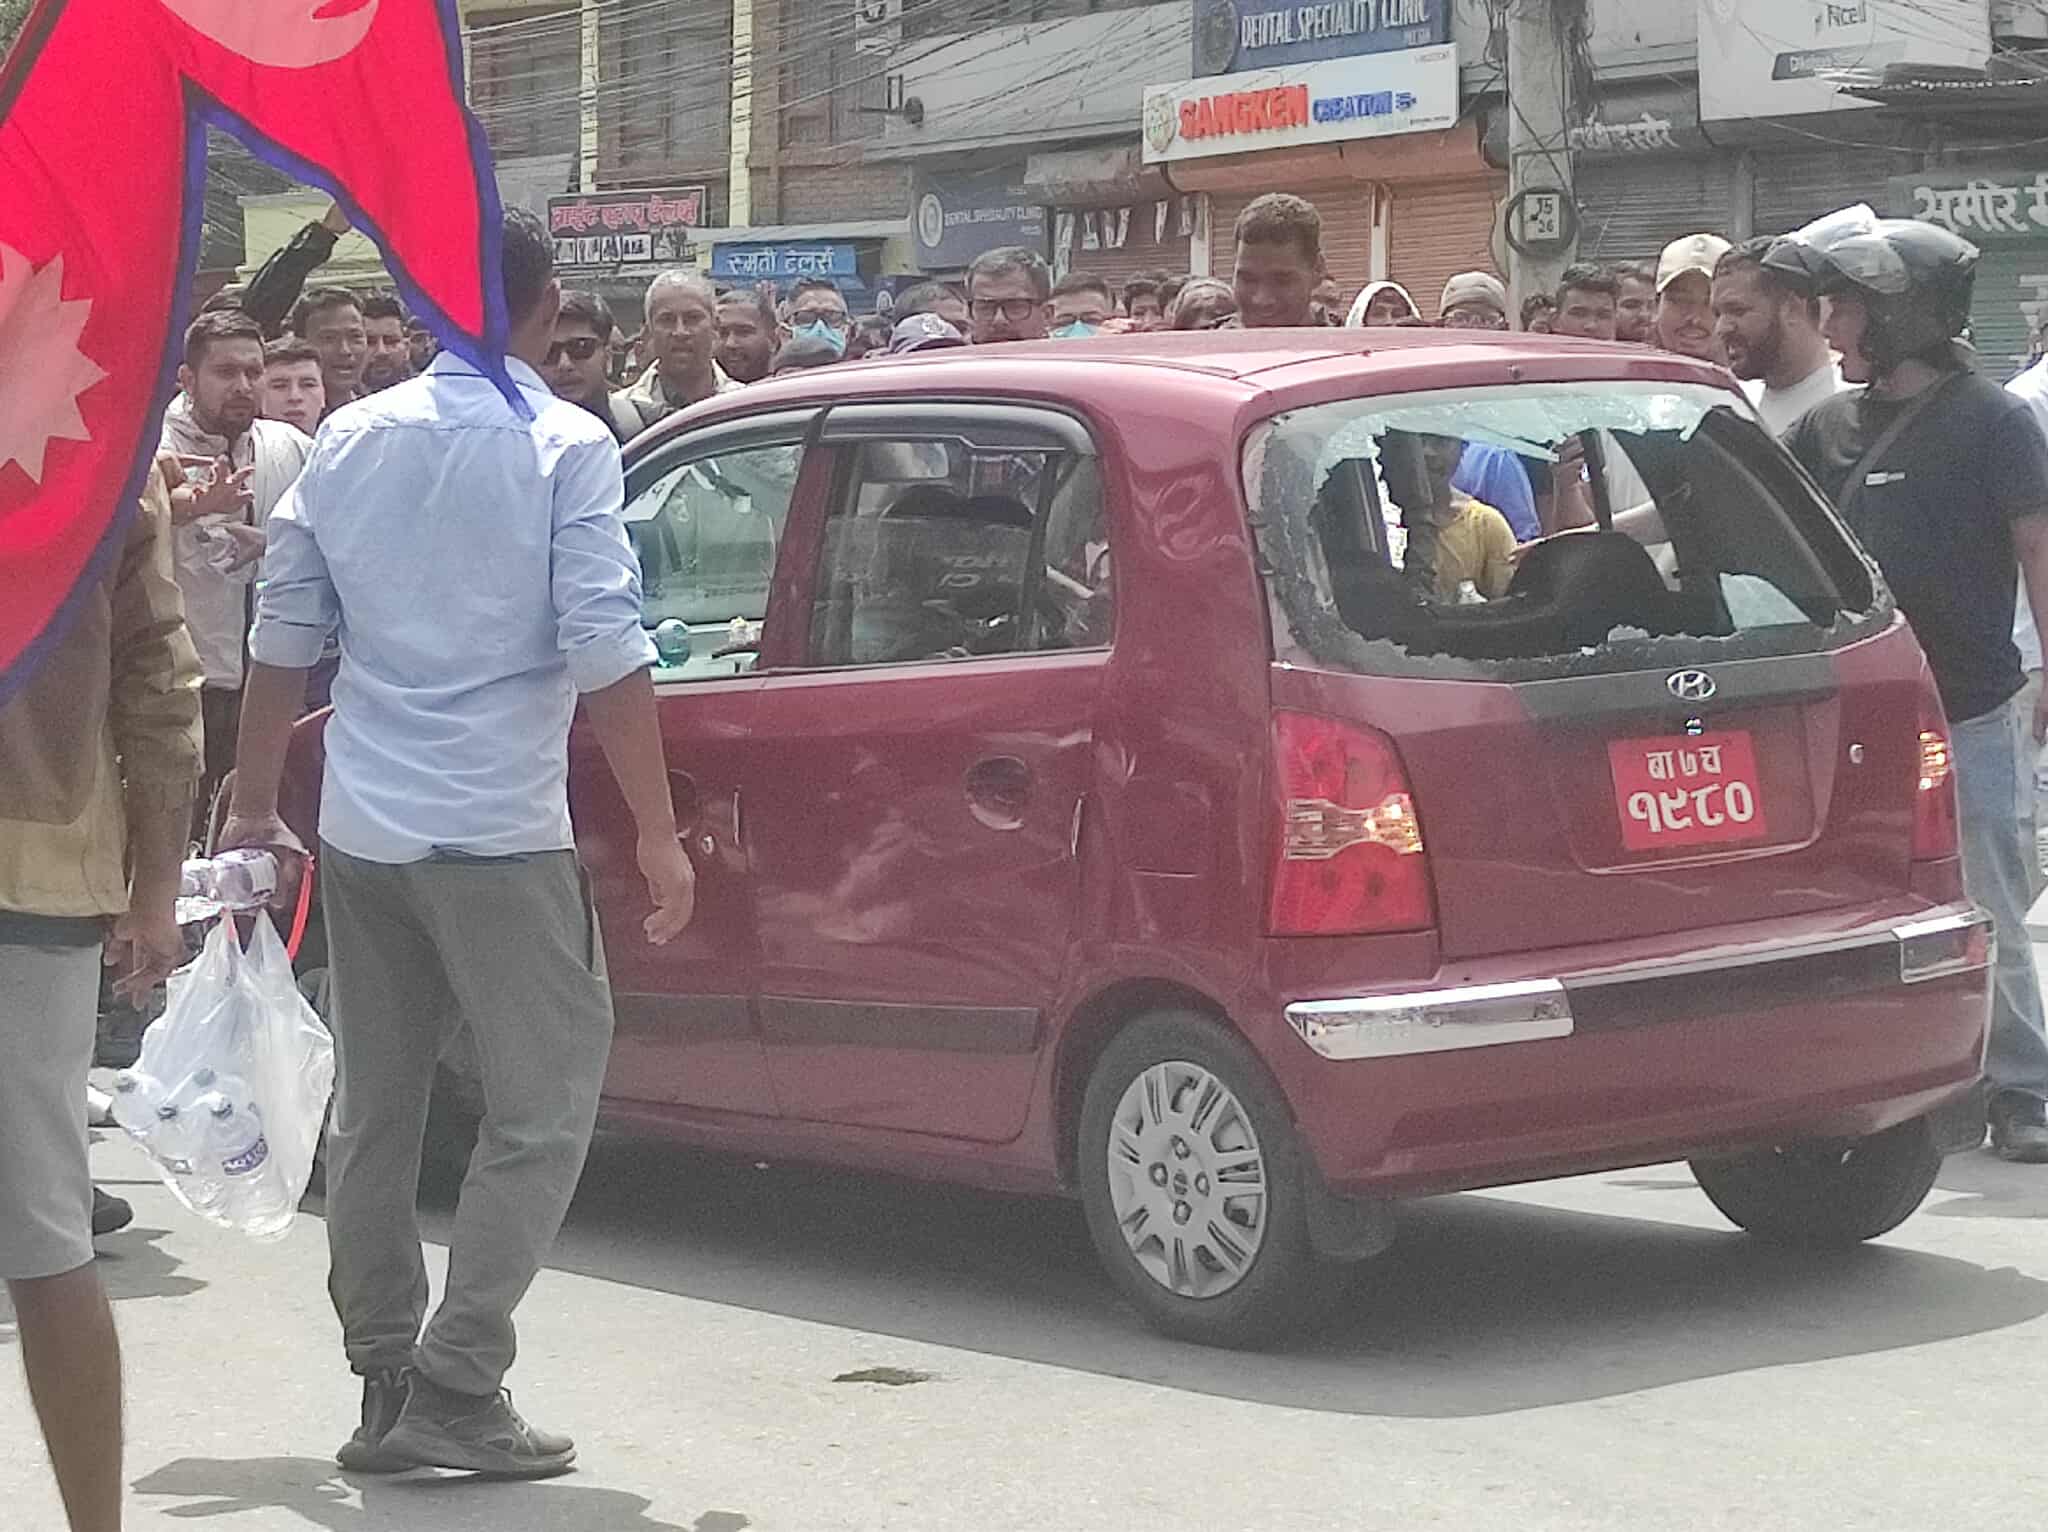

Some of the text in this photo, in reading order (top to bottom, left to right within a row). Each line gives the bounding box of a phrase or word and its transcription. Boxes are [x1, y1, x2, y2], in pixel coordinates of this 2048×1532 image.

[1240, 9, 1296, 48] DENTAL
[1297, 1, 1378, 41] SPECIALITY
[1381, 0, 1429, 28] CLINIC
[1179, 84, 1309, 140] SANGKEN
[1646, 749, 1676, 780] बा
[1699, 744, 1723, 775] च
[1627, 781, 1755, 833] १९८०
